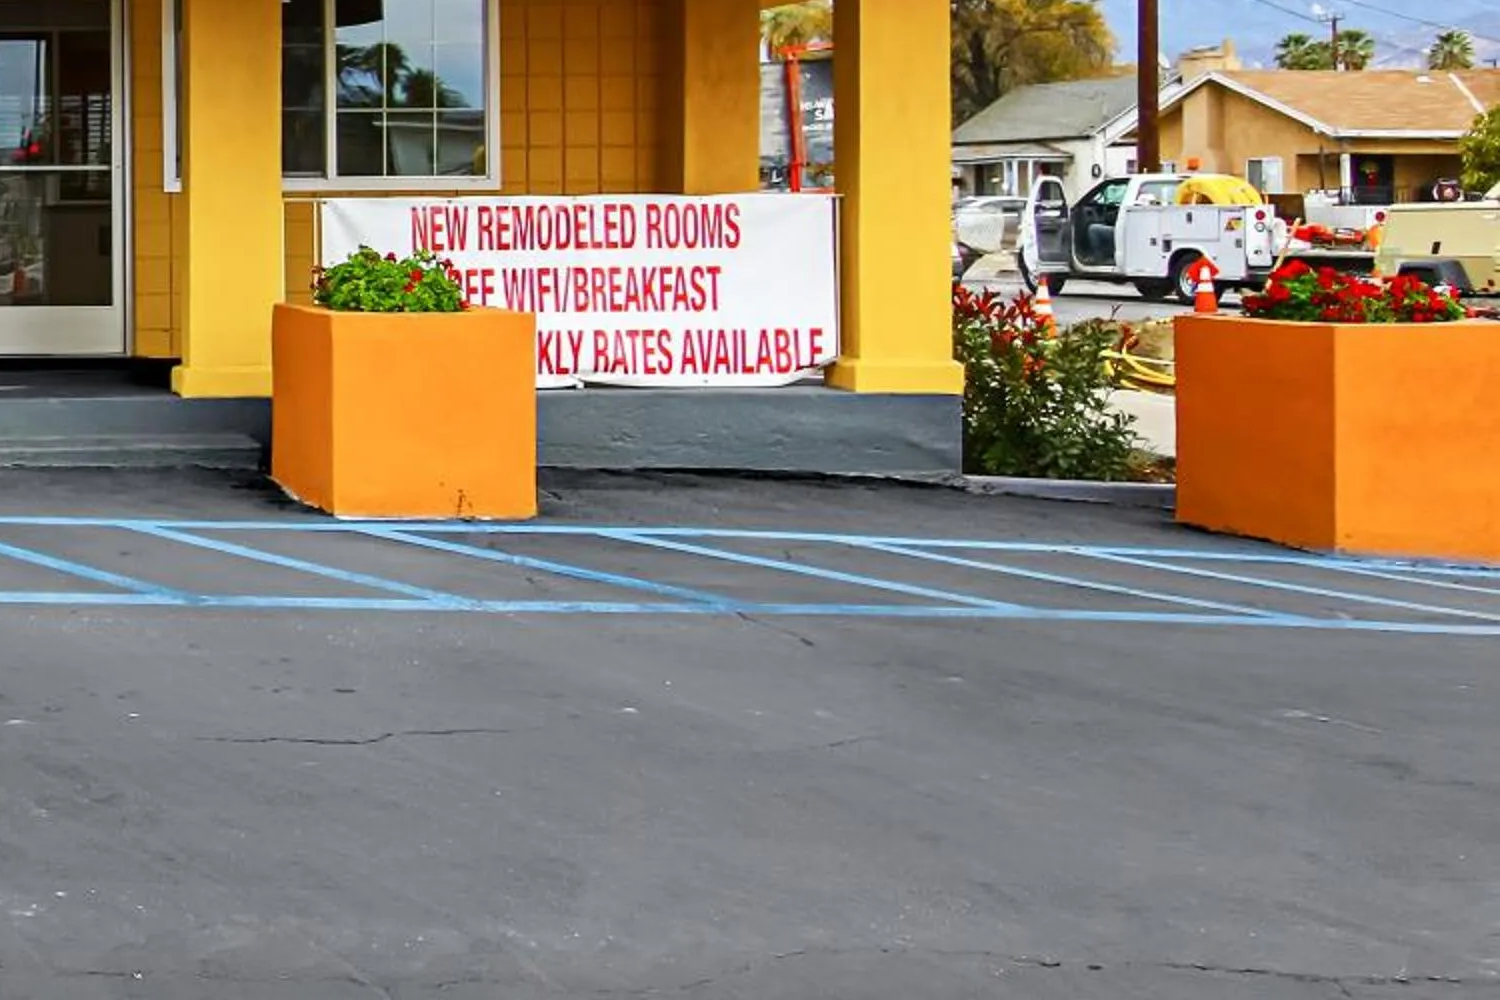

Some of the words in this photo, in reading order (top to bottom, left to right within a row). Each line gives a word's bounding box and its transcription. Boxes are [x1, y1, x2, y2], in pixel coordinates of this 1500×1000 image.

[411, 205, 469, 252] NEW
[477, 202, 637, 251] REMODELED
[645, 202, 742, 250] ROOMS
[501, 265, 722, 313] WIFI/BREAKFAST
[536, 329, 585, 376] KLY
[592, 328, 673, 376] RATES
[679, 327, 824, 376] AVAILABLE
